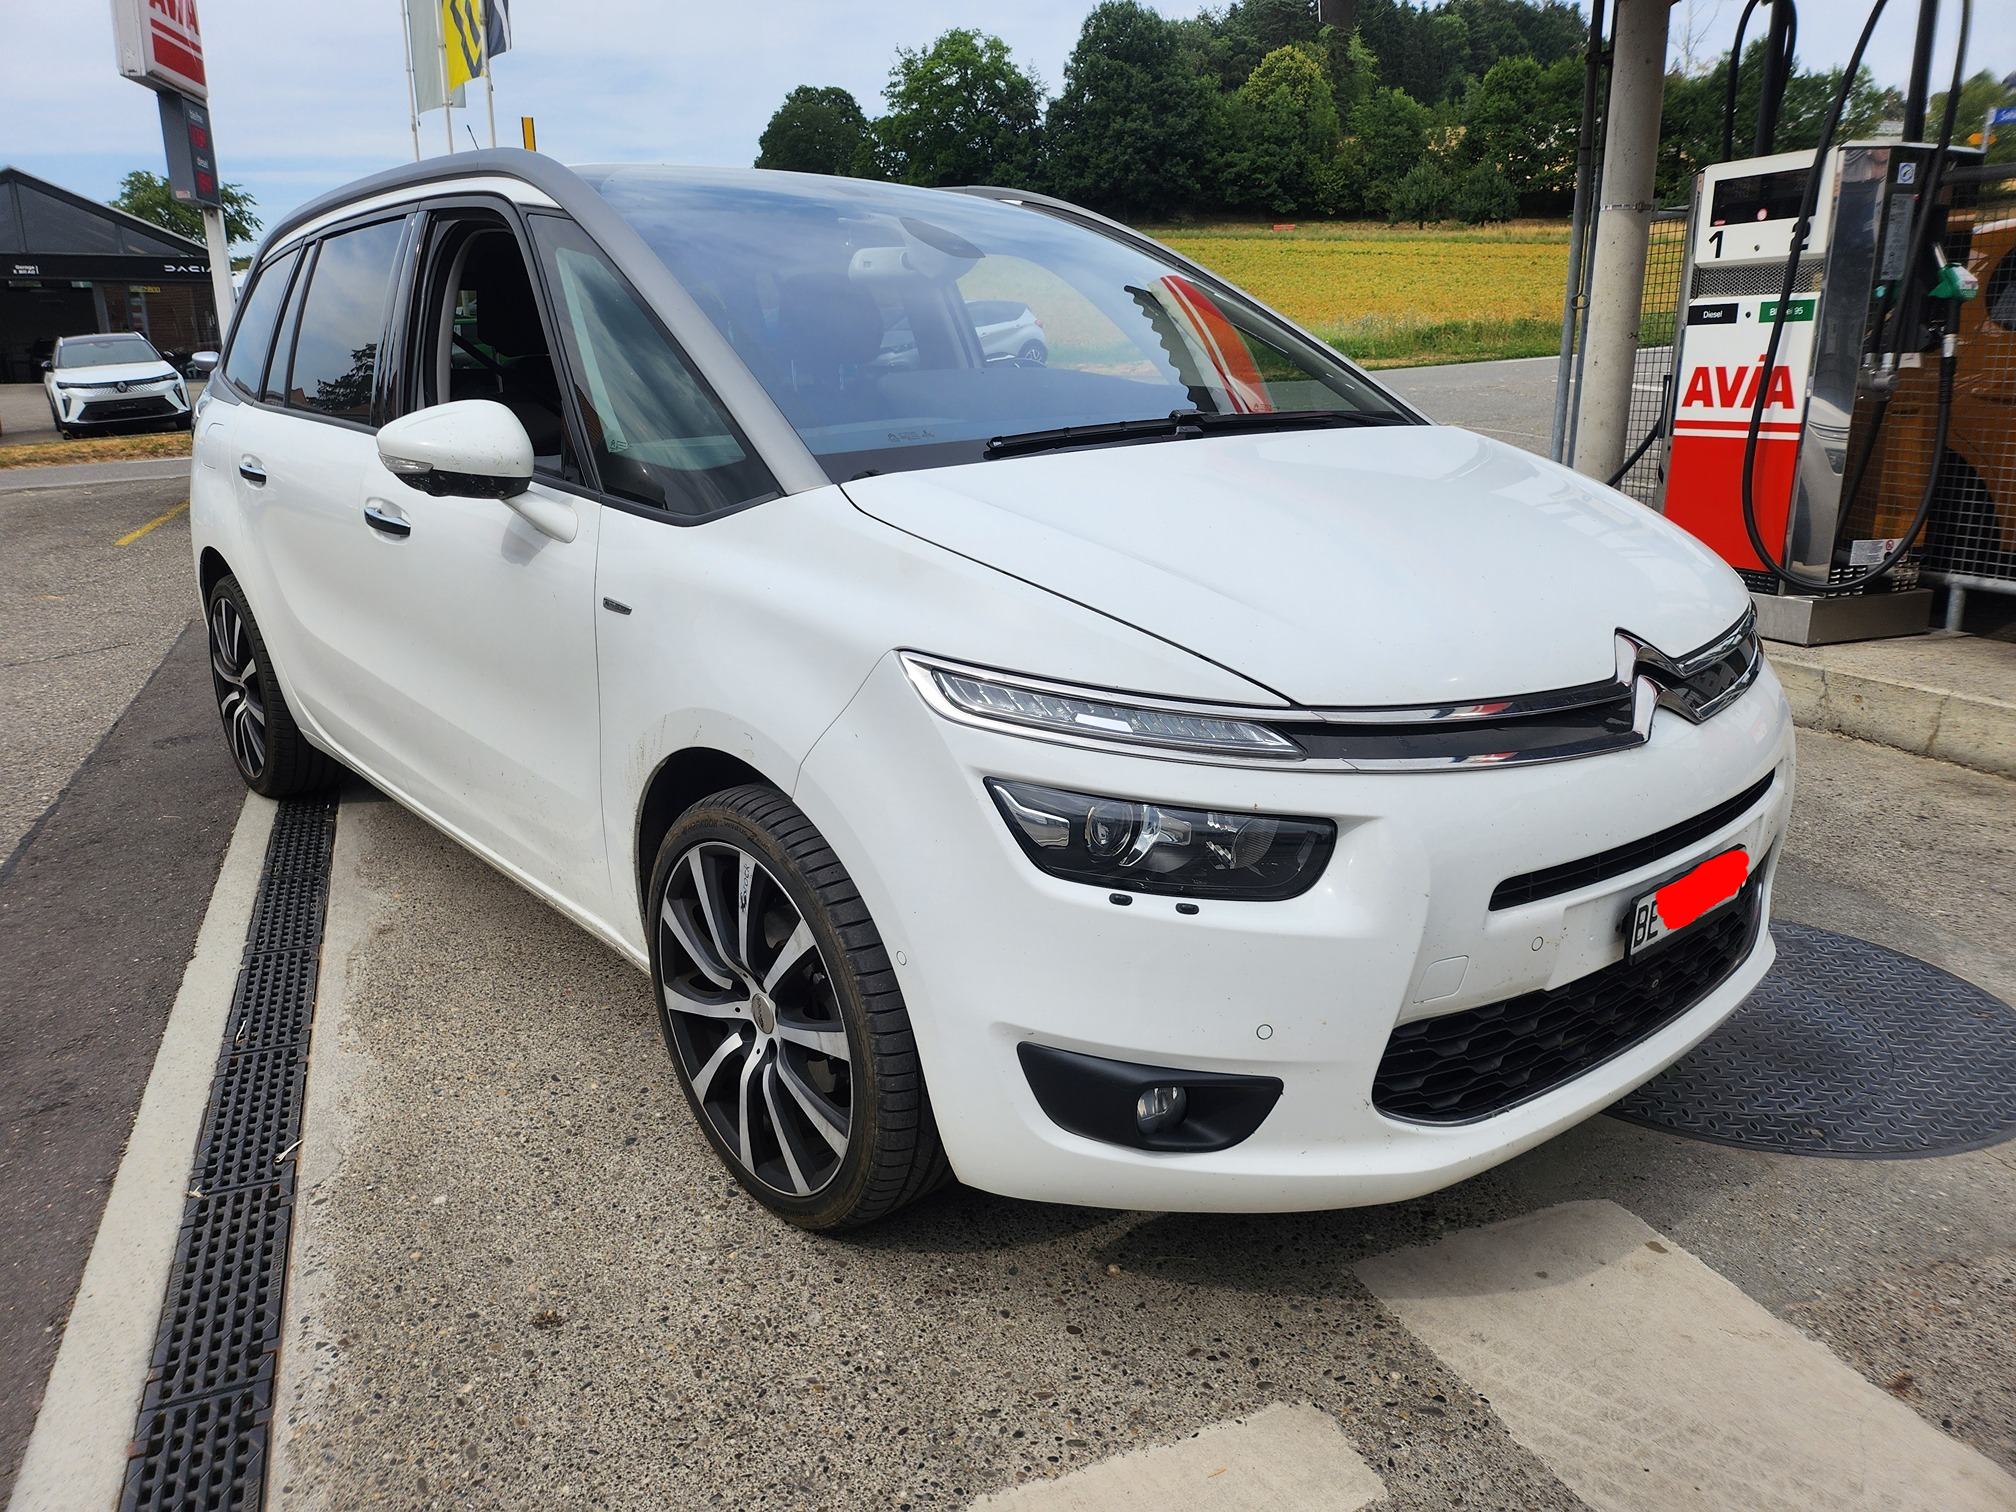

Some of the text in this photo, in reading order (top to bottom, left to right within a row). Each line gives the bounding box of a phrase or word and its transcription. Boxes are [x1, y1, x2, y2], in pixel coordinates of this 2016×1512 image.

[149, 0, 199, 36] VIA
[1708, 230, 1724, 259] 1
[1703, 310, 1723, 319] Diesel
[1793, 306, 1804, 315] 95
[1633, 900, 1659, 948] BE
